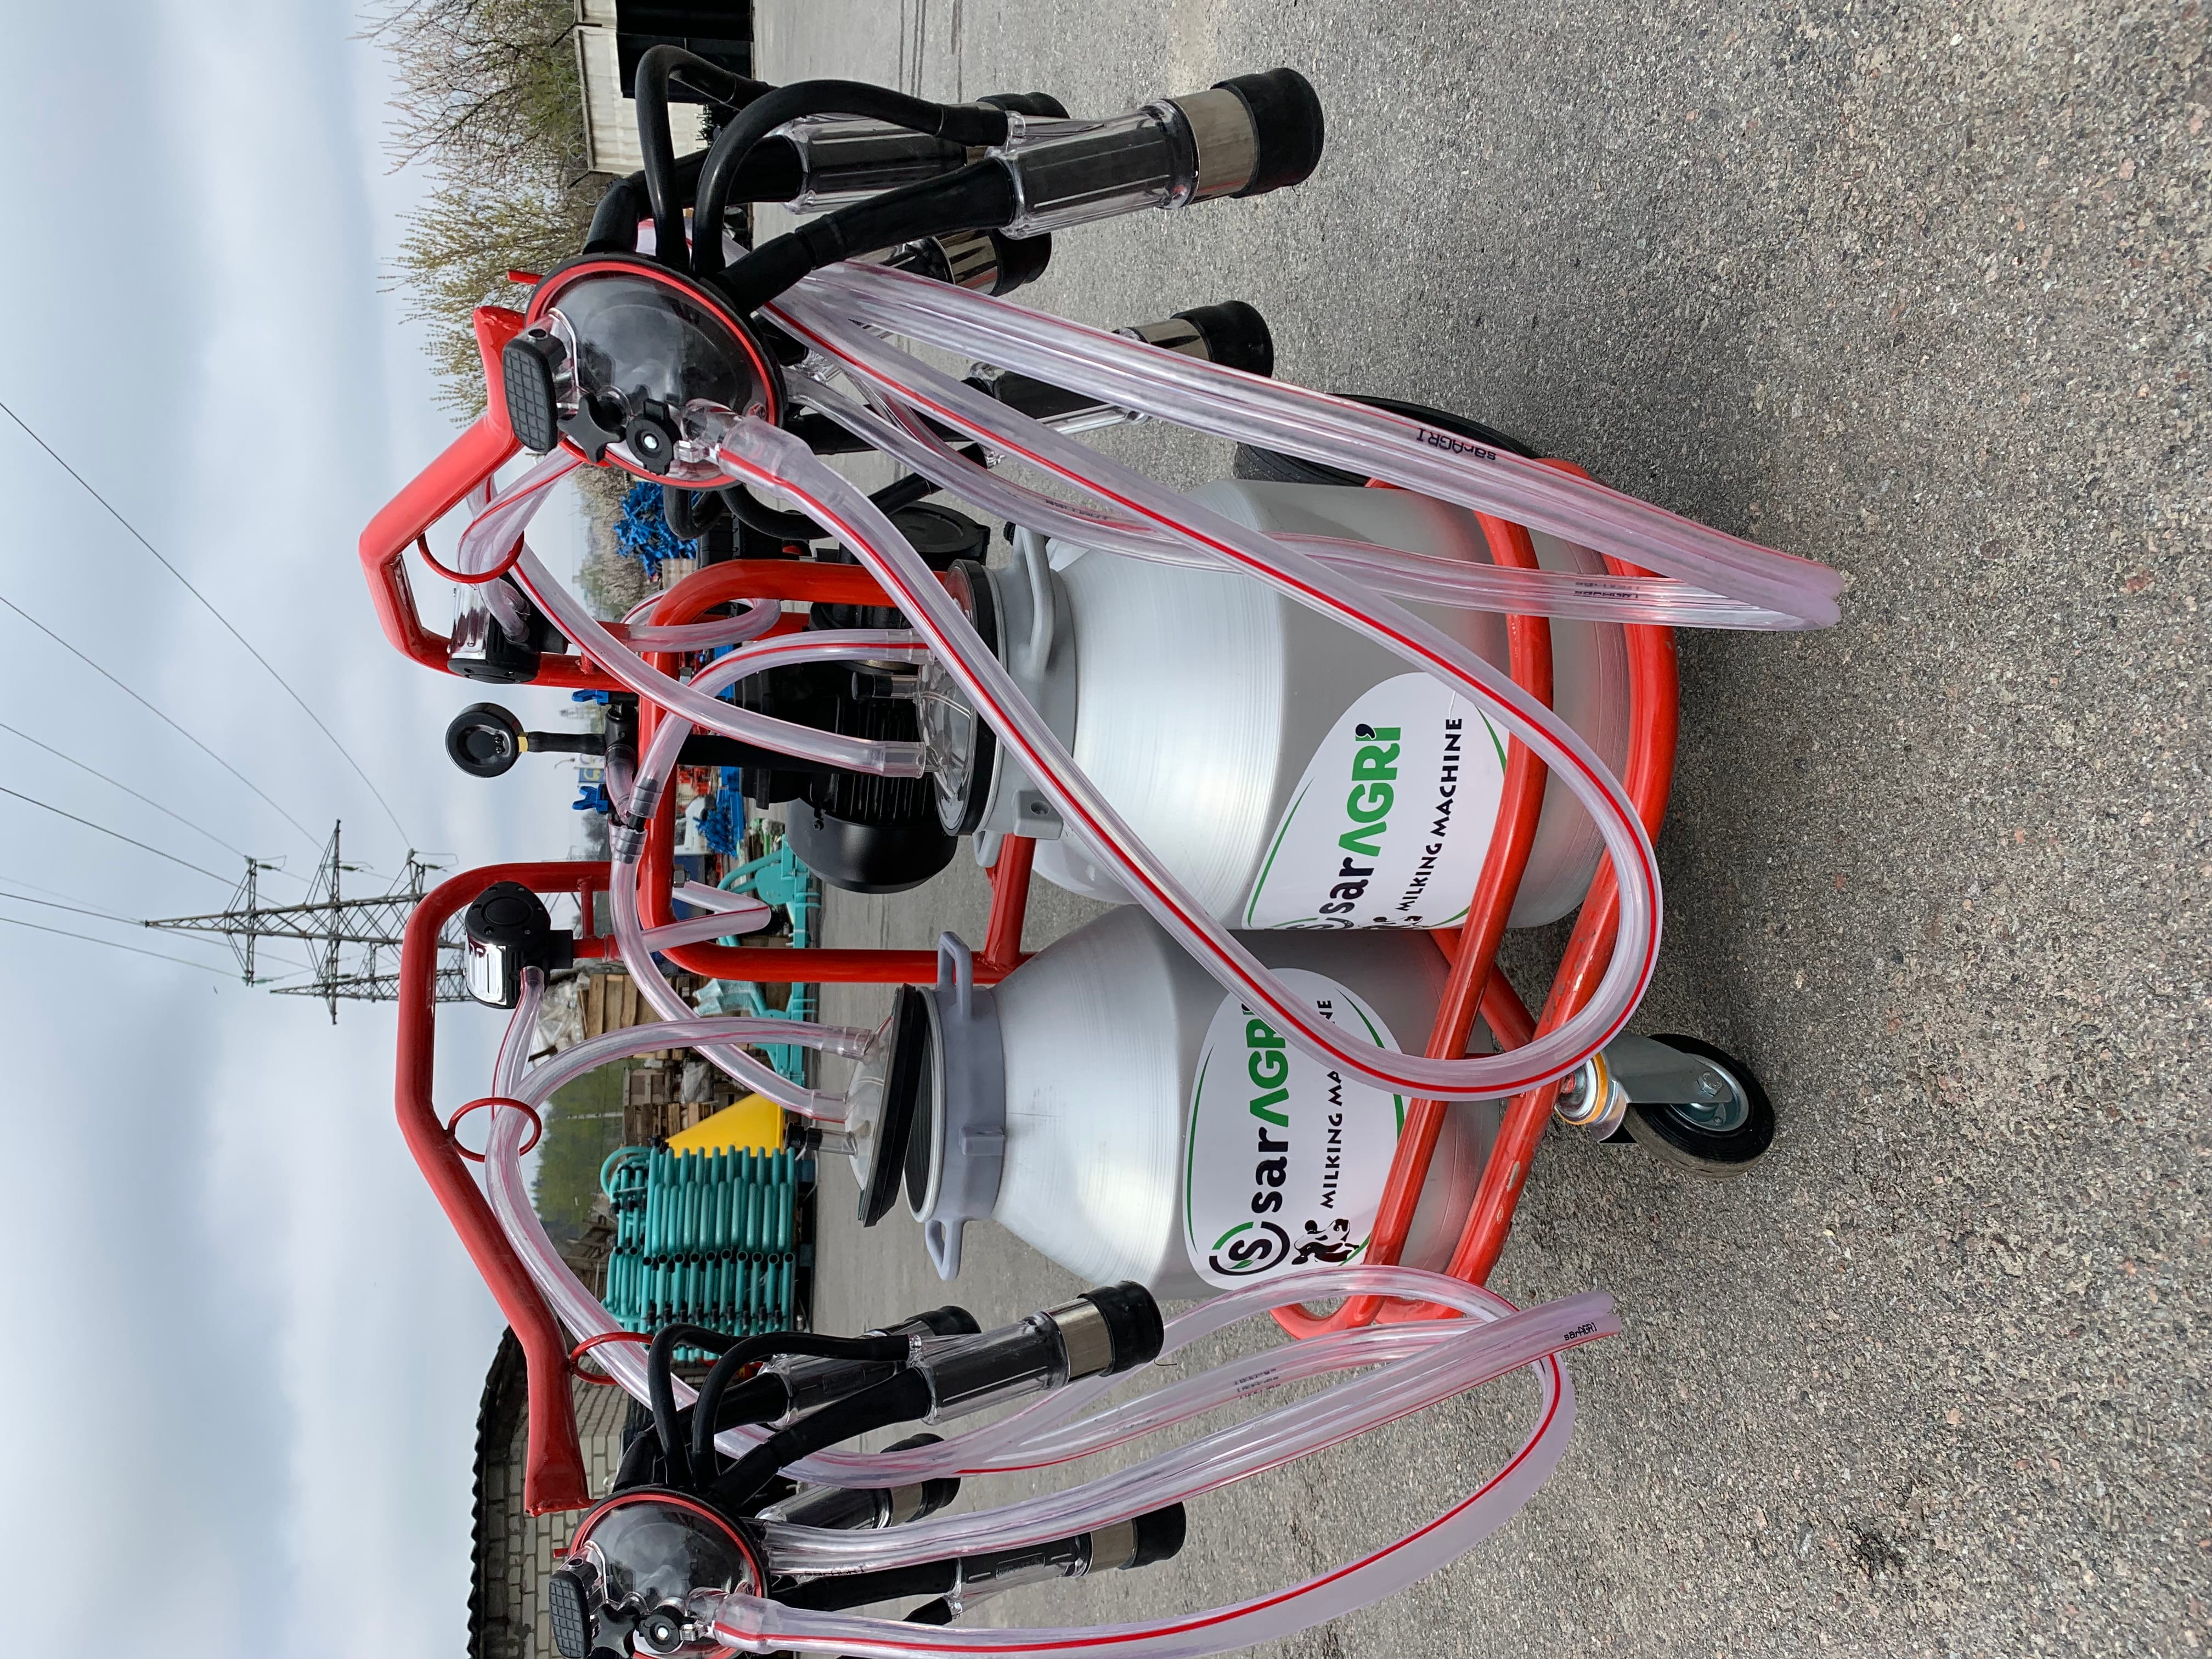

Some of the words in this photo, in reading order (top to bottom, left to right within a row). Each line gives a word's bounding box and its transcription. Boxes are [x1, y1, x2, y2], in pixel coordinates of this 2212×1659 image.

[1416, 428, 1496, 460] sarAGRI
[1394, 843, 1443, 911] MILKING
[1430, 718, 1463, 837] MACHINE
[1316, 1000, 1343, 1106] MANE
[1319, 1113, 1343, 1209] MILKING
[1564, 1322, 1597, 1341] sarAGRI
